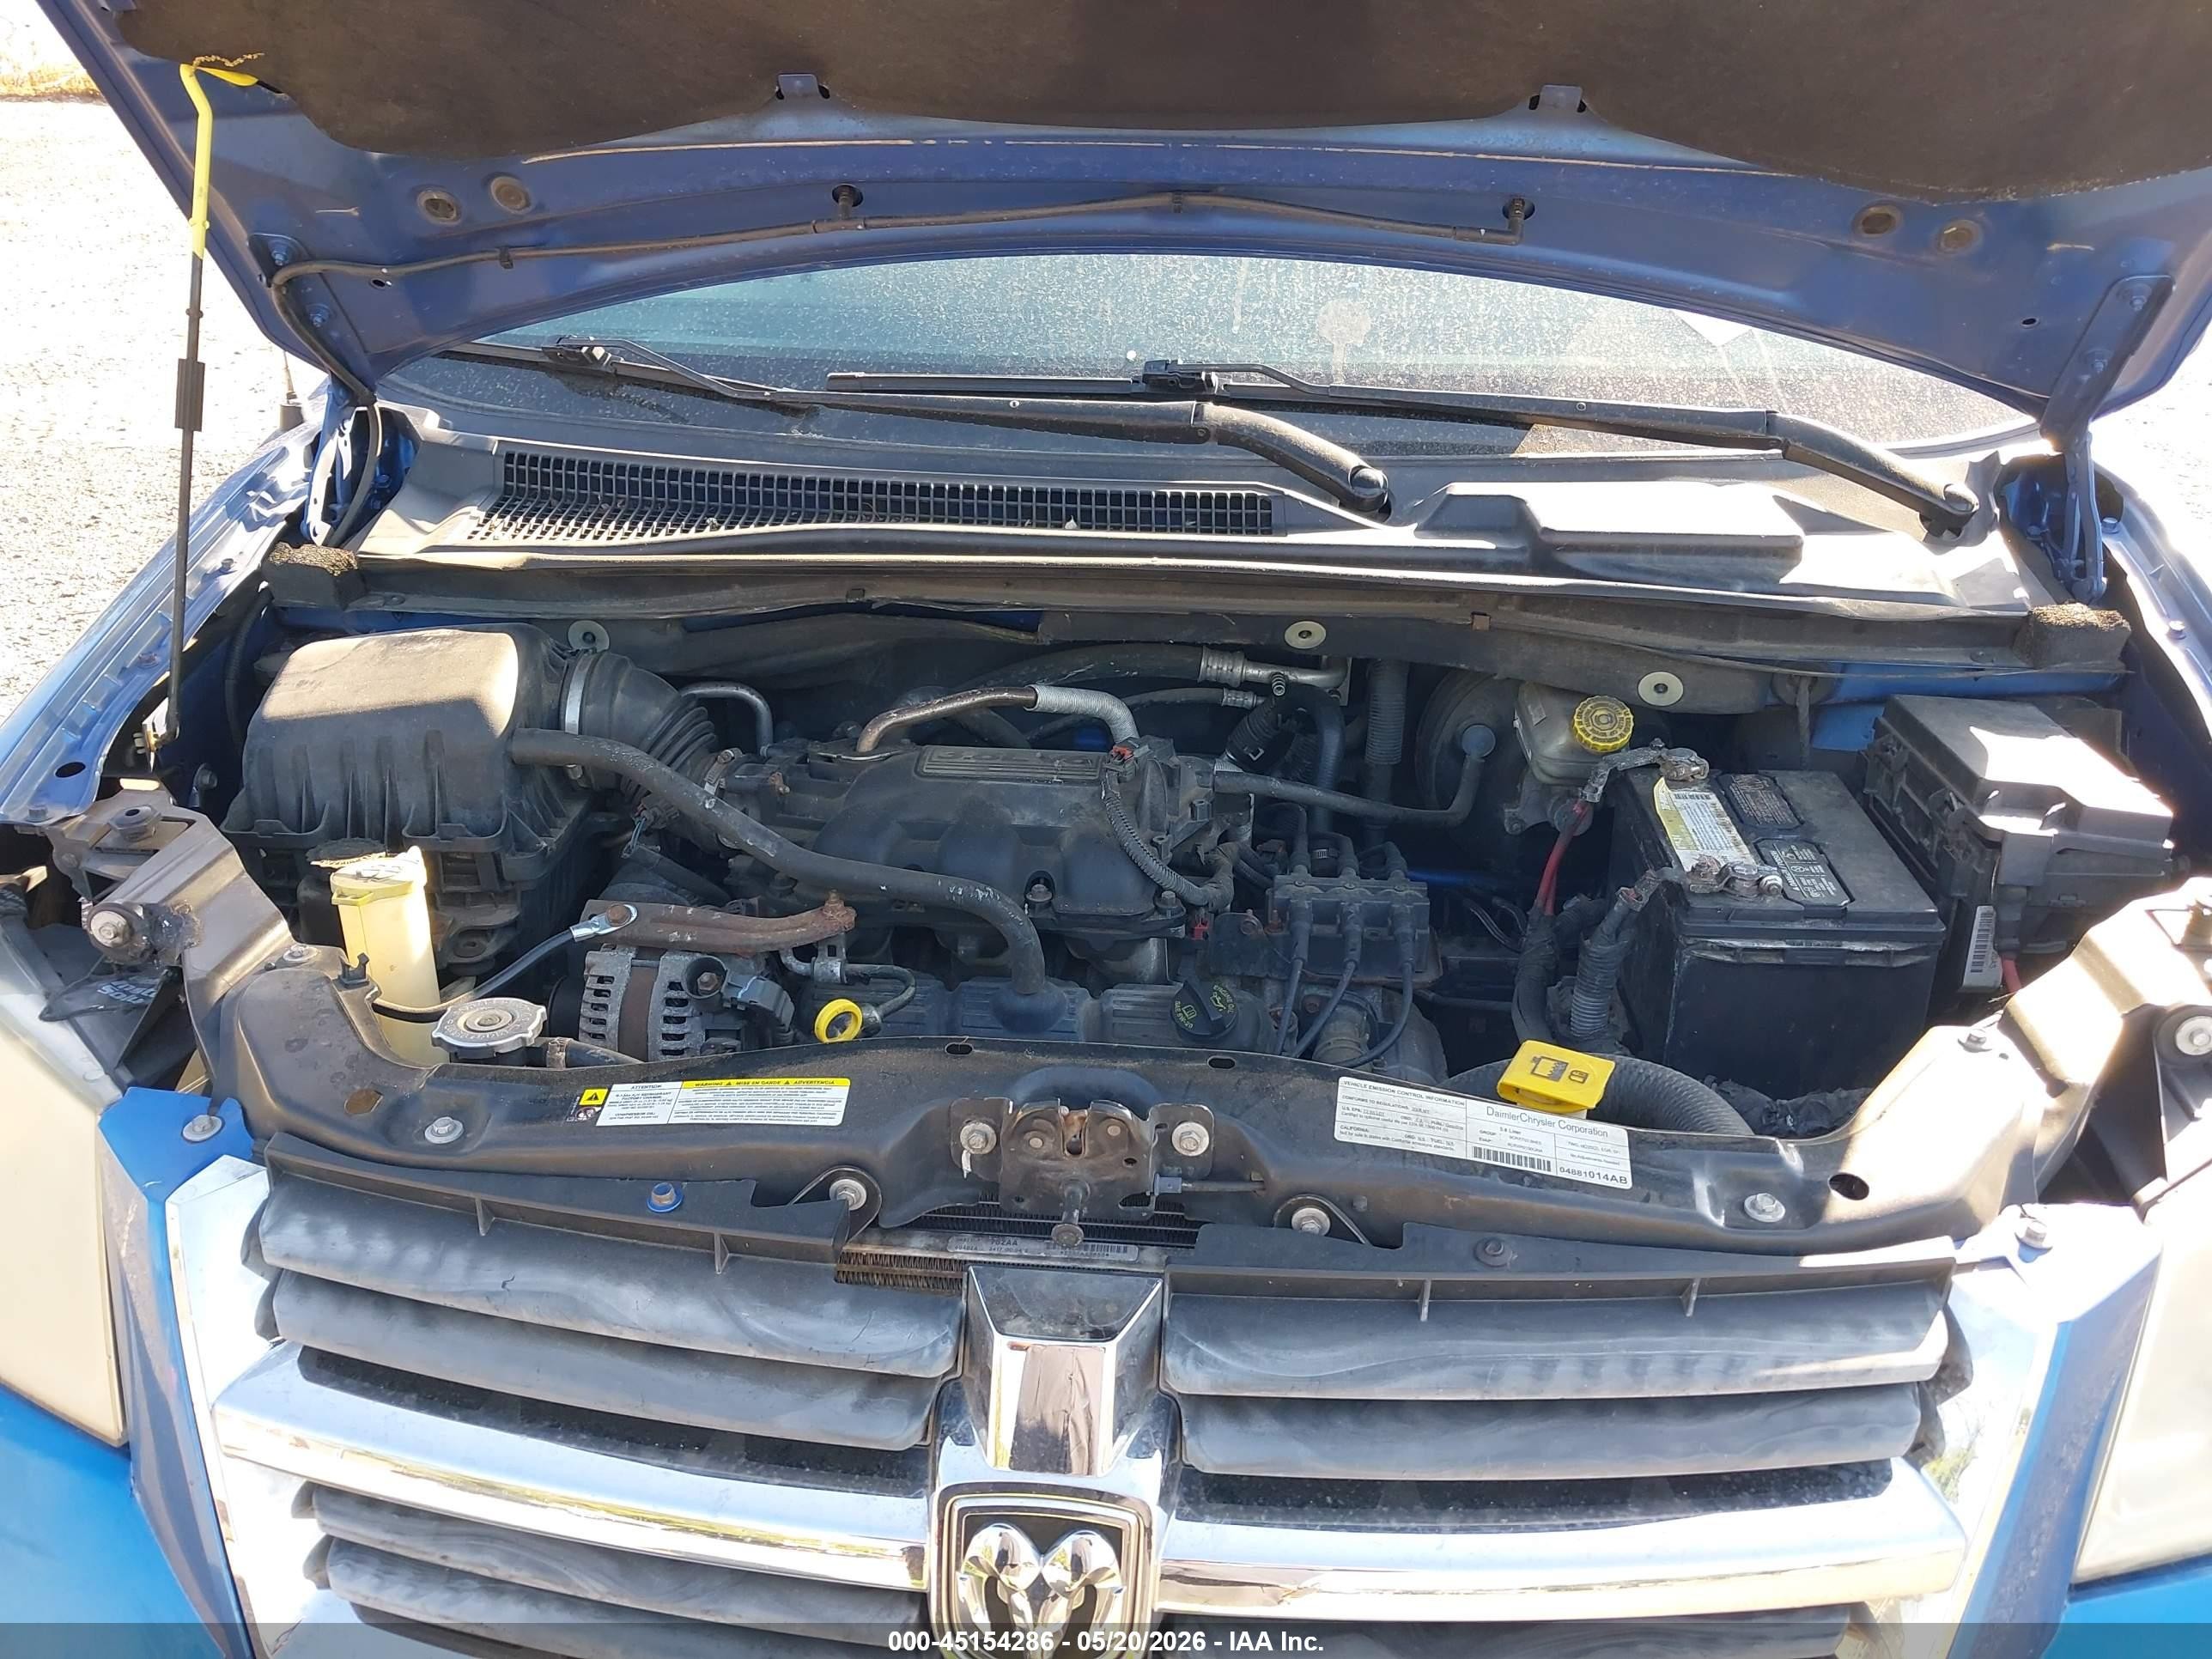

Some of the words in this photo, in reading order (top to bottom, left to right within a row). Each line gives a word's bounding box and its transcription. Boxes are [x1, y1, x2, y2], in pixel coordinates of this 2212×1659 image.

[1341, 1095, 1368, 1103] CONFORMS
[1344, 1080, 1368, 1089] VEHICLE
[1368, 1085, 1396, 1094] EMISSION
[1397, 1090, 1425, 1099] CONTROL
[1425, 1095, 1465, 1106] INFORMATION
[1486, 1105, 1556, 1128] DaimlerChrysler
[1558, 1119, 1608, 1139] Corporation
